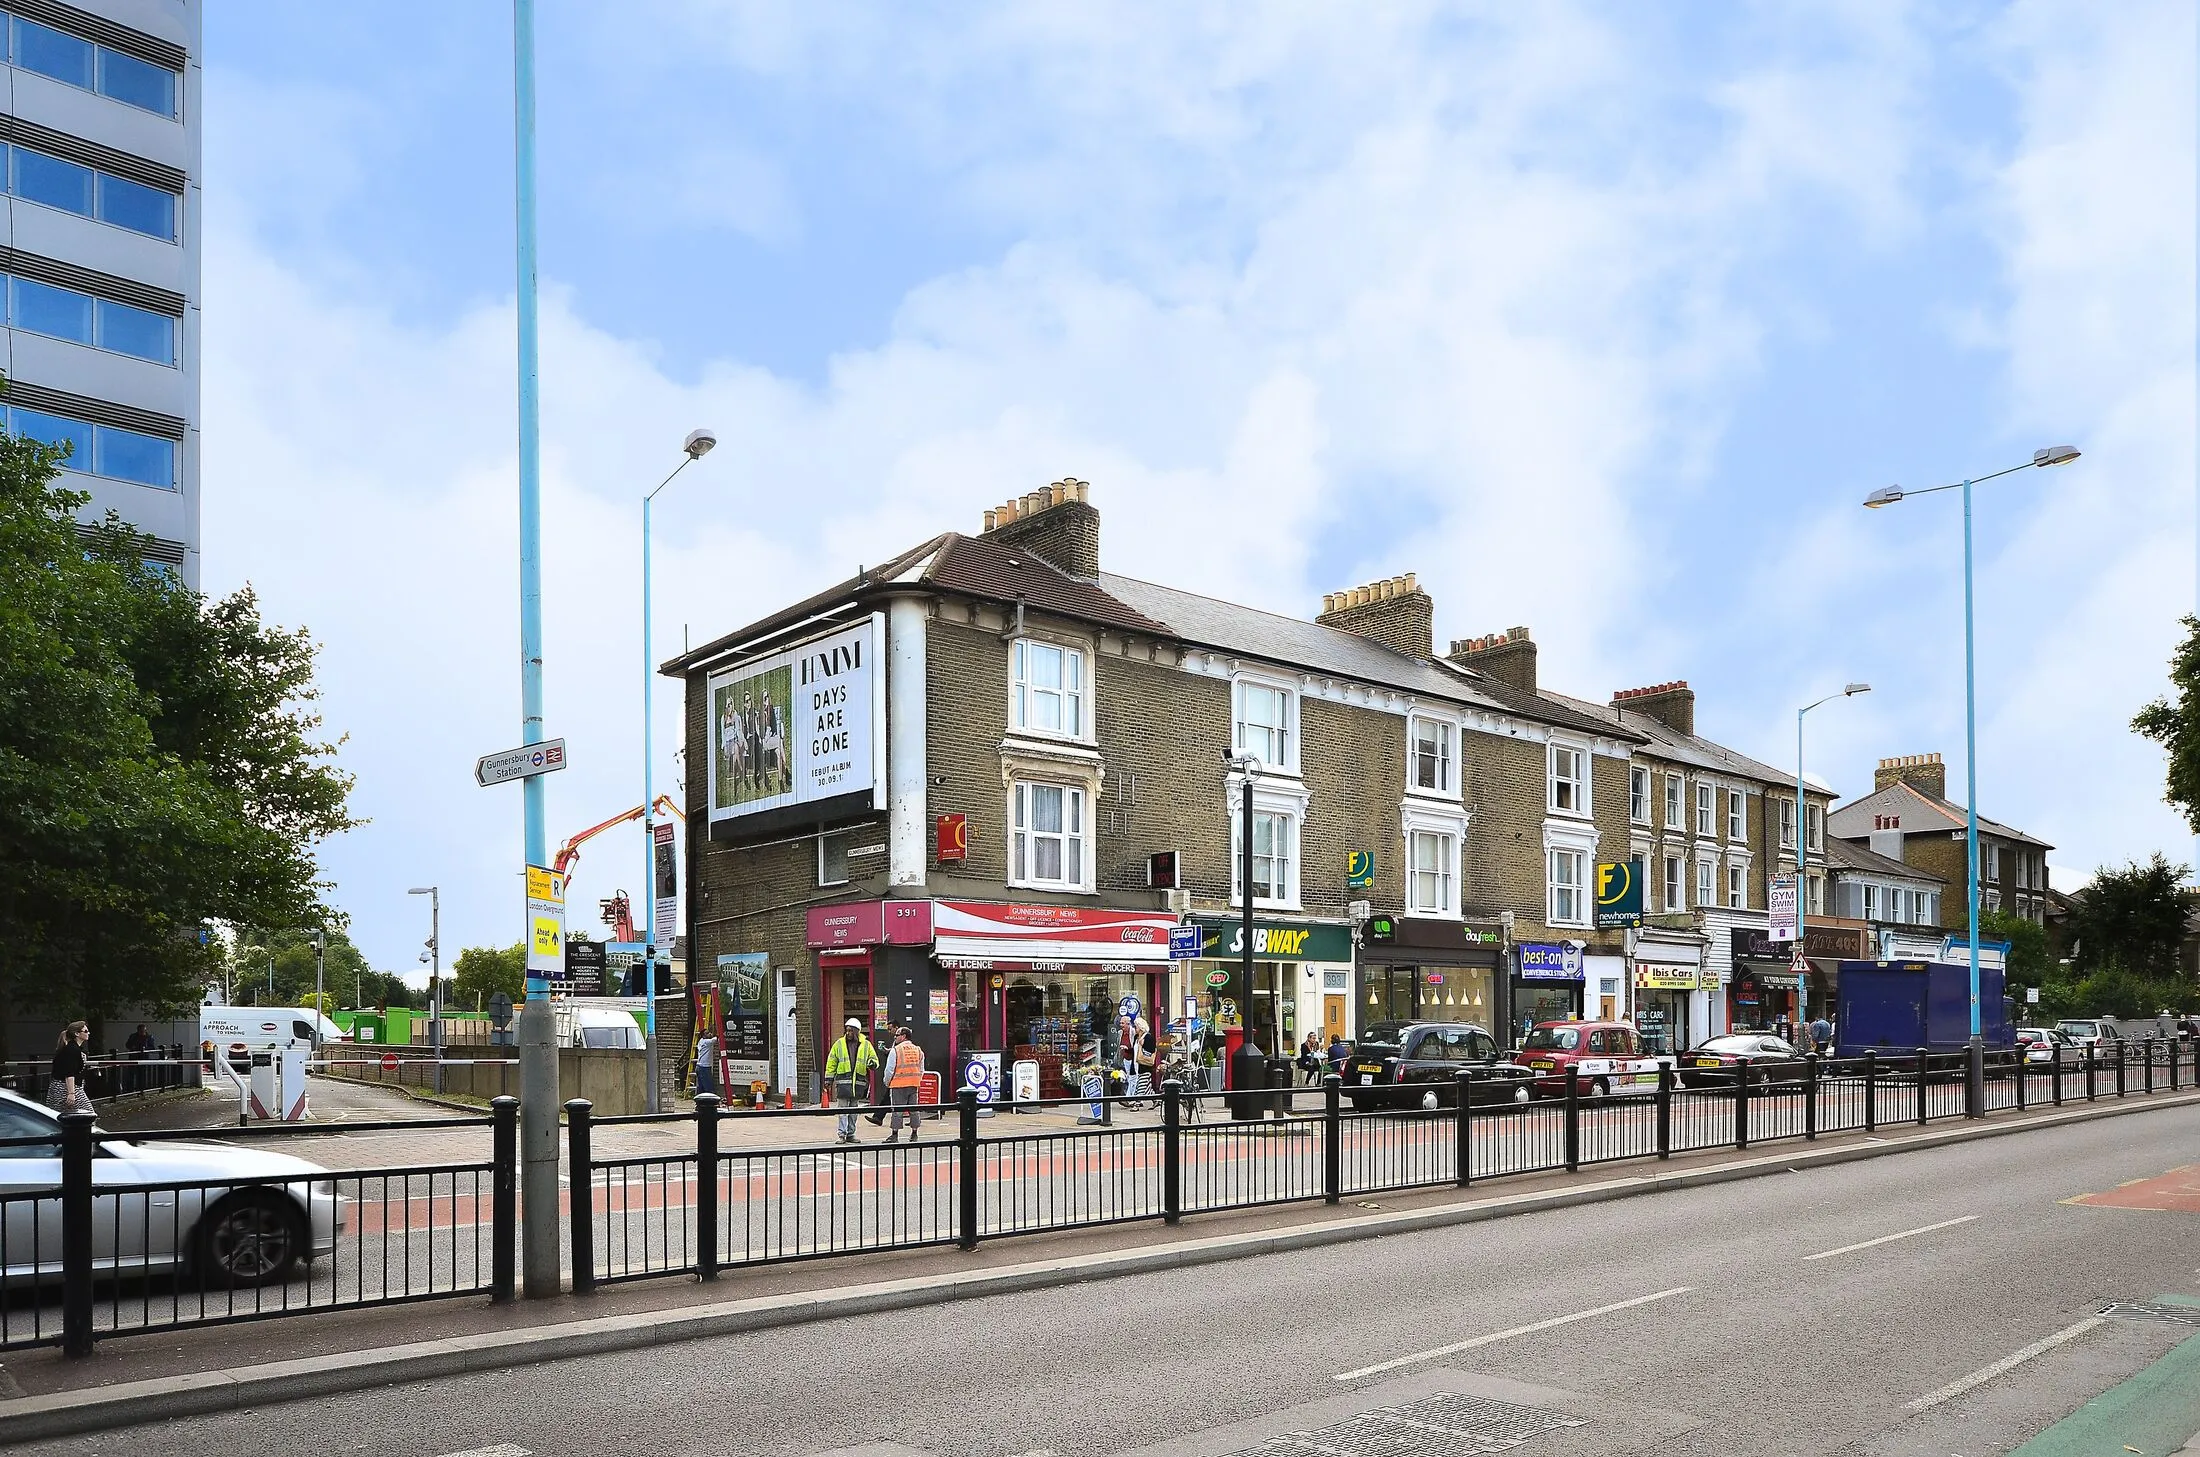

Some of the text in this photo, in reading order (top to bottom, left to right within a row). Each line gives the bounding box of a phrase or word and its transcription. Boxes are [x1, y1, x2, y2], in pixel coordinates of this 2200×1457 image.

[814, 685, 847, 710] DAYS
[817, 709, 843, 733] ARE
[813, 732, 848, 757] GONE
[487, 753, 530, 769] Gunnersbury
[497, 766, 522, 778] Station
[1349, 852, 1358, 872] F
[1599, 864, 1616, 896] F
[553, 880, 559, 896] R
[1771, 891, 1794, 901] GYM
[529, 903, 564, 914] London Overground
[1771, 900, 1794, 908] SWIM
[897, 909, 917, 917] 391
[1012, 908, 1056, 916] GUNNERSBURY
[1599, 912, 1640, 920] newhomes
[824, 916, 857, 926] GUNNERSBURY
[537, 928, 549, 937] Ahead
[833, 929, 848, 937] NEWS
[539, 937, 548, 946] only
[1836, 937, 1858, 952] 403
[1524, 947, 1561, 965] best-on
[942, 960, 993, 969] OFF LICENCE
[1032, 962, 1065, 971] LOTTERY
[1102, 964, 1136, 972] GROCERS
[1168, 965, 1178, 973] 391
[1653, 968, 1692, 977] Ibis Cars
[1209, 974, 1226, 983] OPEN
[1327, 975, 1342, 985] 393
[1743, 982, 1752, 990] OFF
[1650, 1011, 1663, 1019] CARS
